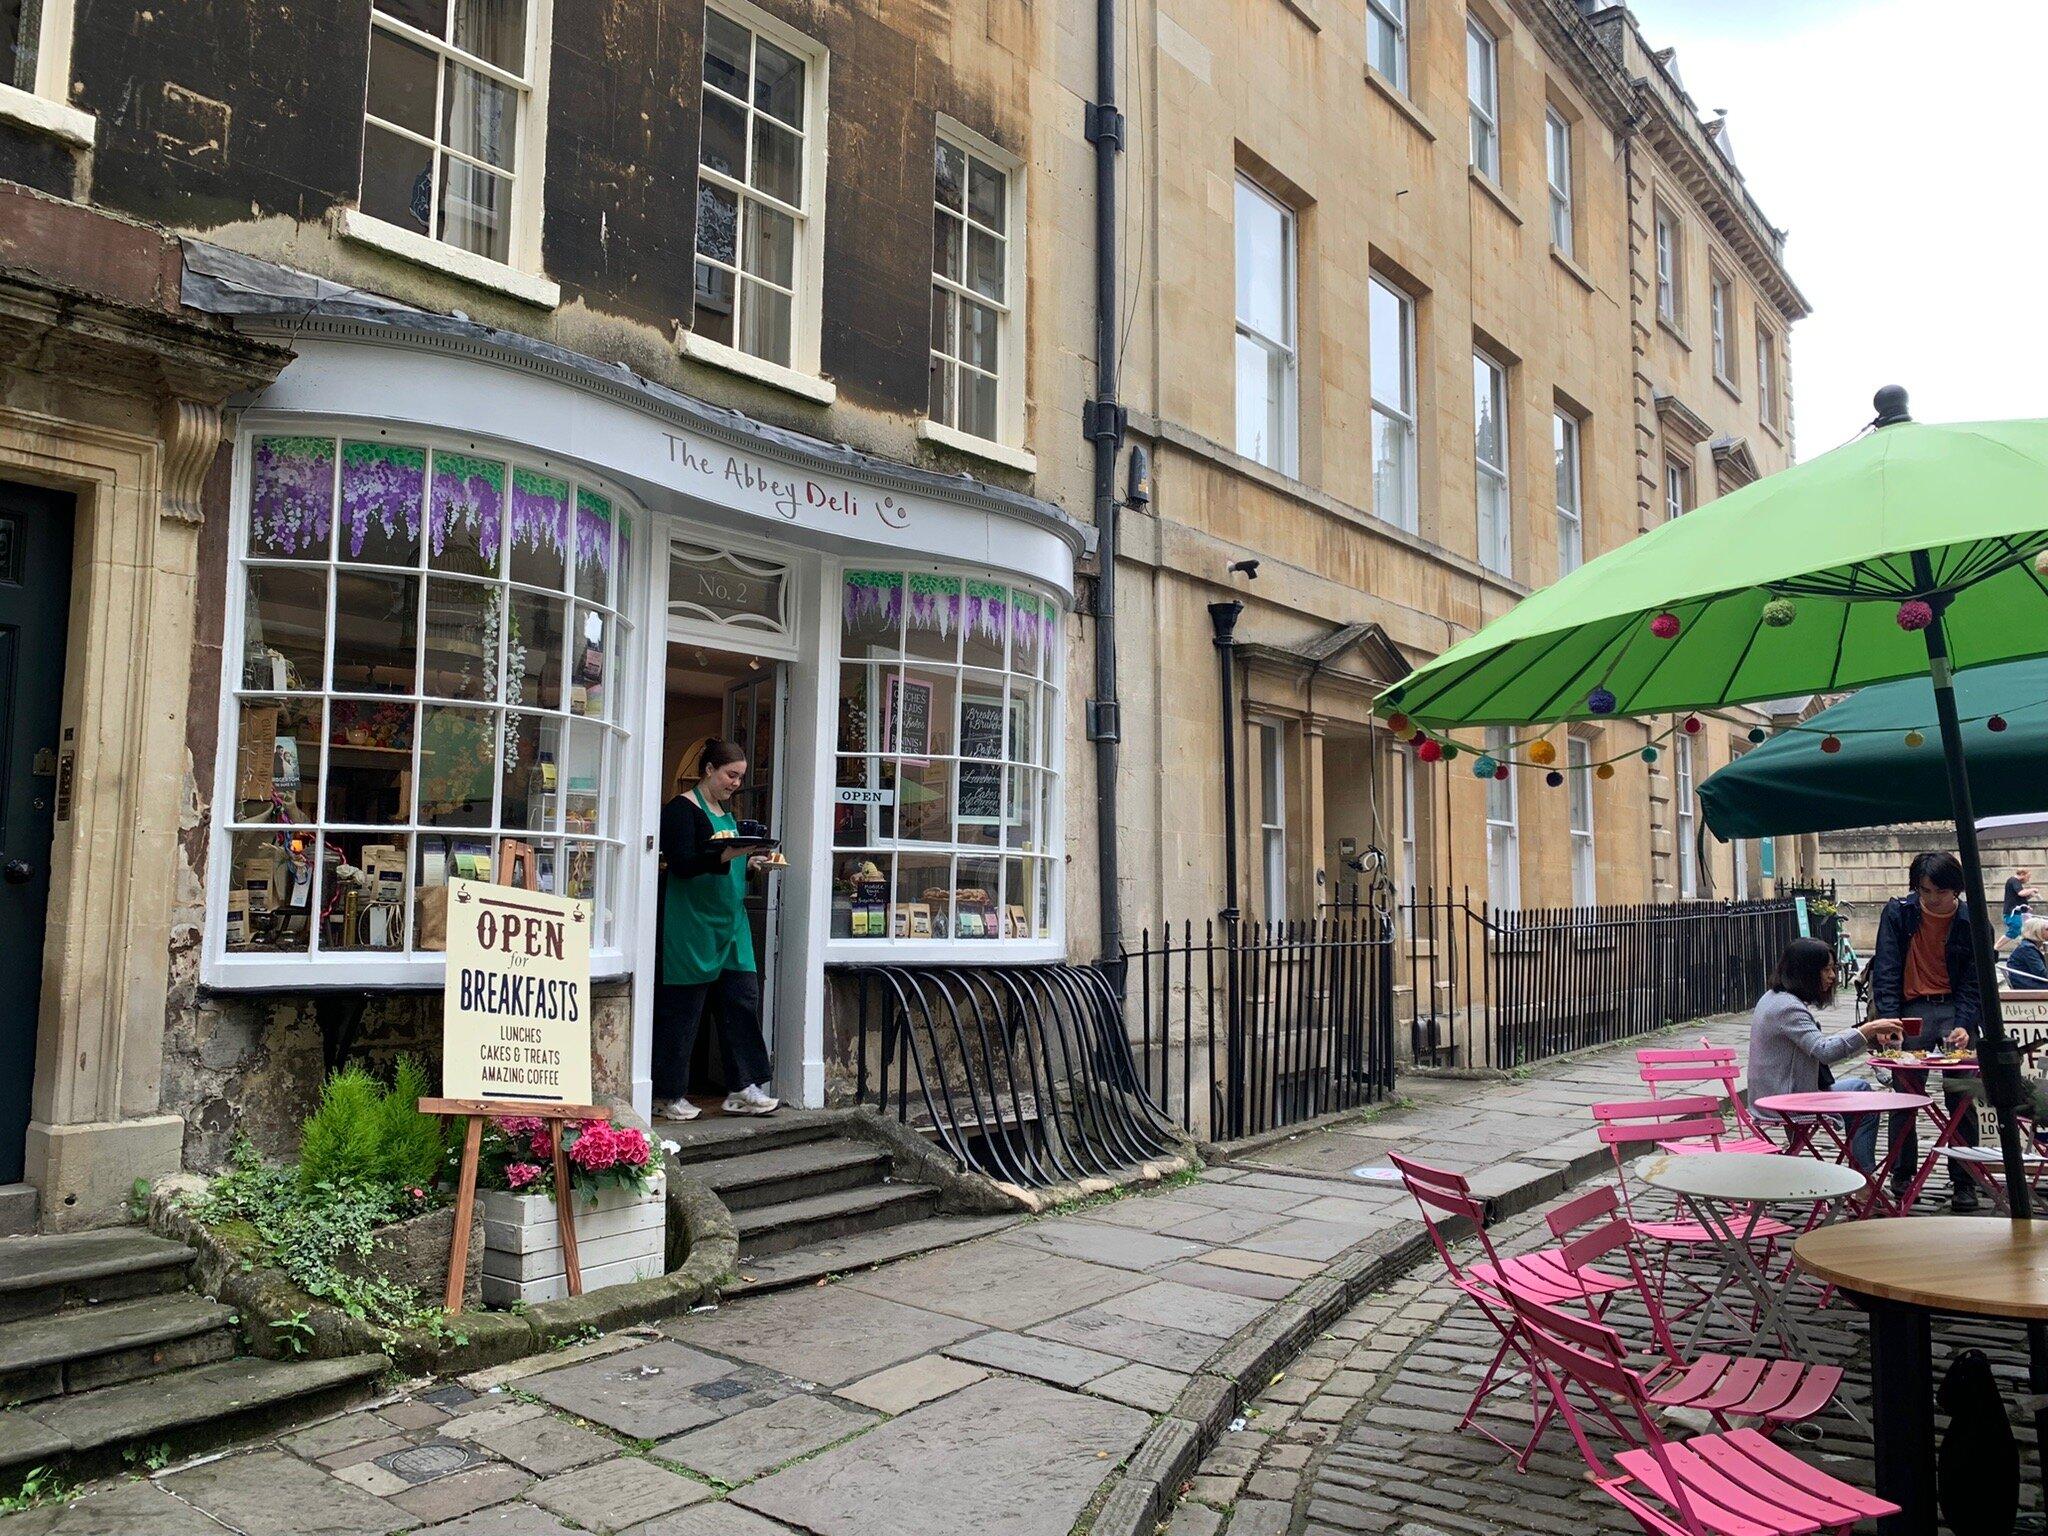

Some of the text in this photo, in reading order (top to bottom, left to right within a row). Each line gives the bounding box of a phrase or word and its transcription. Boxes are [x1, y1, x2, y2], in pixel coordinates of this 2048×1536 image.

[662, 432, 858, 519] The Abbey Deli
[697, 573, 749, 603] No. 2
[891, 734, 919, 748] PNINIS
[842, 791, 883, 802] OPEN
[476, 910, 565, 961] OPEN
[507, 951, 529, 970] for
[460, 968, 579, 1023] BREAKFASTS
[2005, 1005, 2036, 1023] Abbey
[500, 1025, 542, 1044] LUNCHES
[480, 1044, 560, 1065] CAKES & TREATS
[481, 1066, 559, 1086] AMAZING COFFEE
